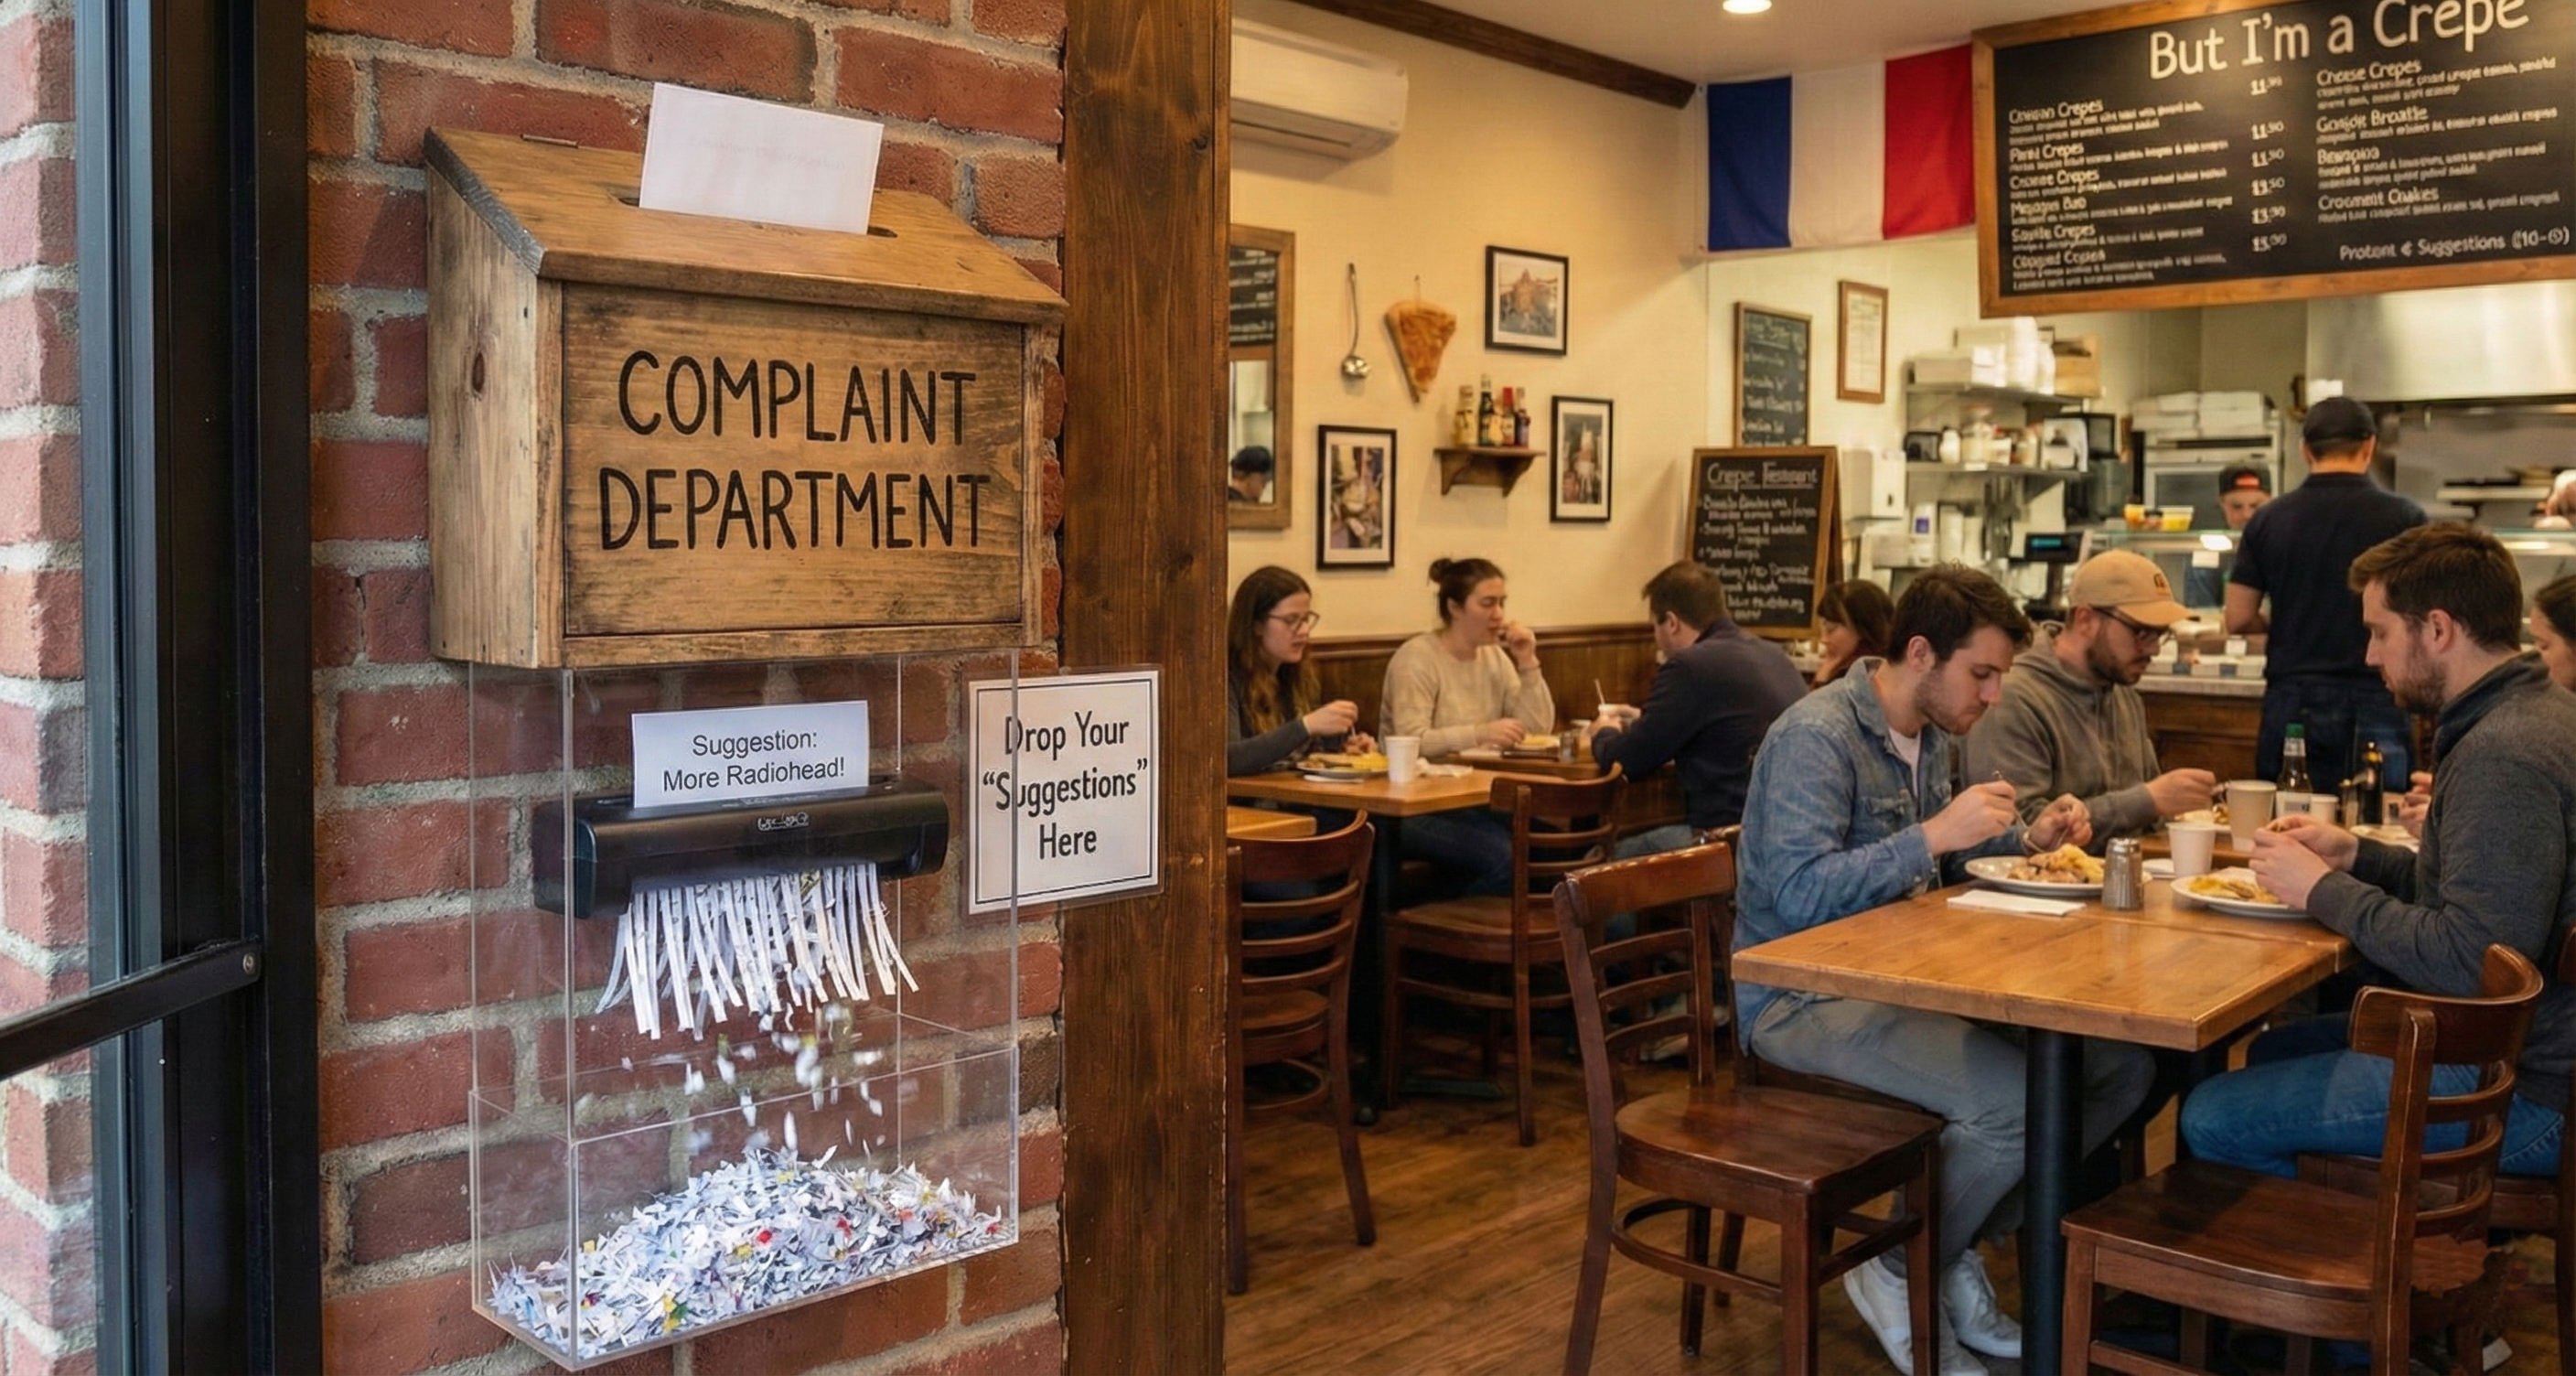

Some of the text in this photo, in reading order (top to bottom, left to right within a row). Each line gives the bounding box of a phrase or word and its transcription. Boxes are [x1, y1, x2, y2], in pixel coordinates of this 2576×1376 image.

[2150, 27, 2228, 80] But
[2327, 14, 2355, 55] a
[2373, 0, 2530, 53] Crepe
[2417, 234, 2506, 259] Suggestions
[618, 349, 977, 446] COMPLAINT
[599, 467, 991, 550] DEPARTMENT
[692, 729, 818, 760] Suggestion:
[1005, 710, 1131, 761] Drop Your
[663, 757, 845, 792] More Radiohead!
[982, 757, 1148, 818] “Suggestions”
[1039, 822, 1098, 860] Here
